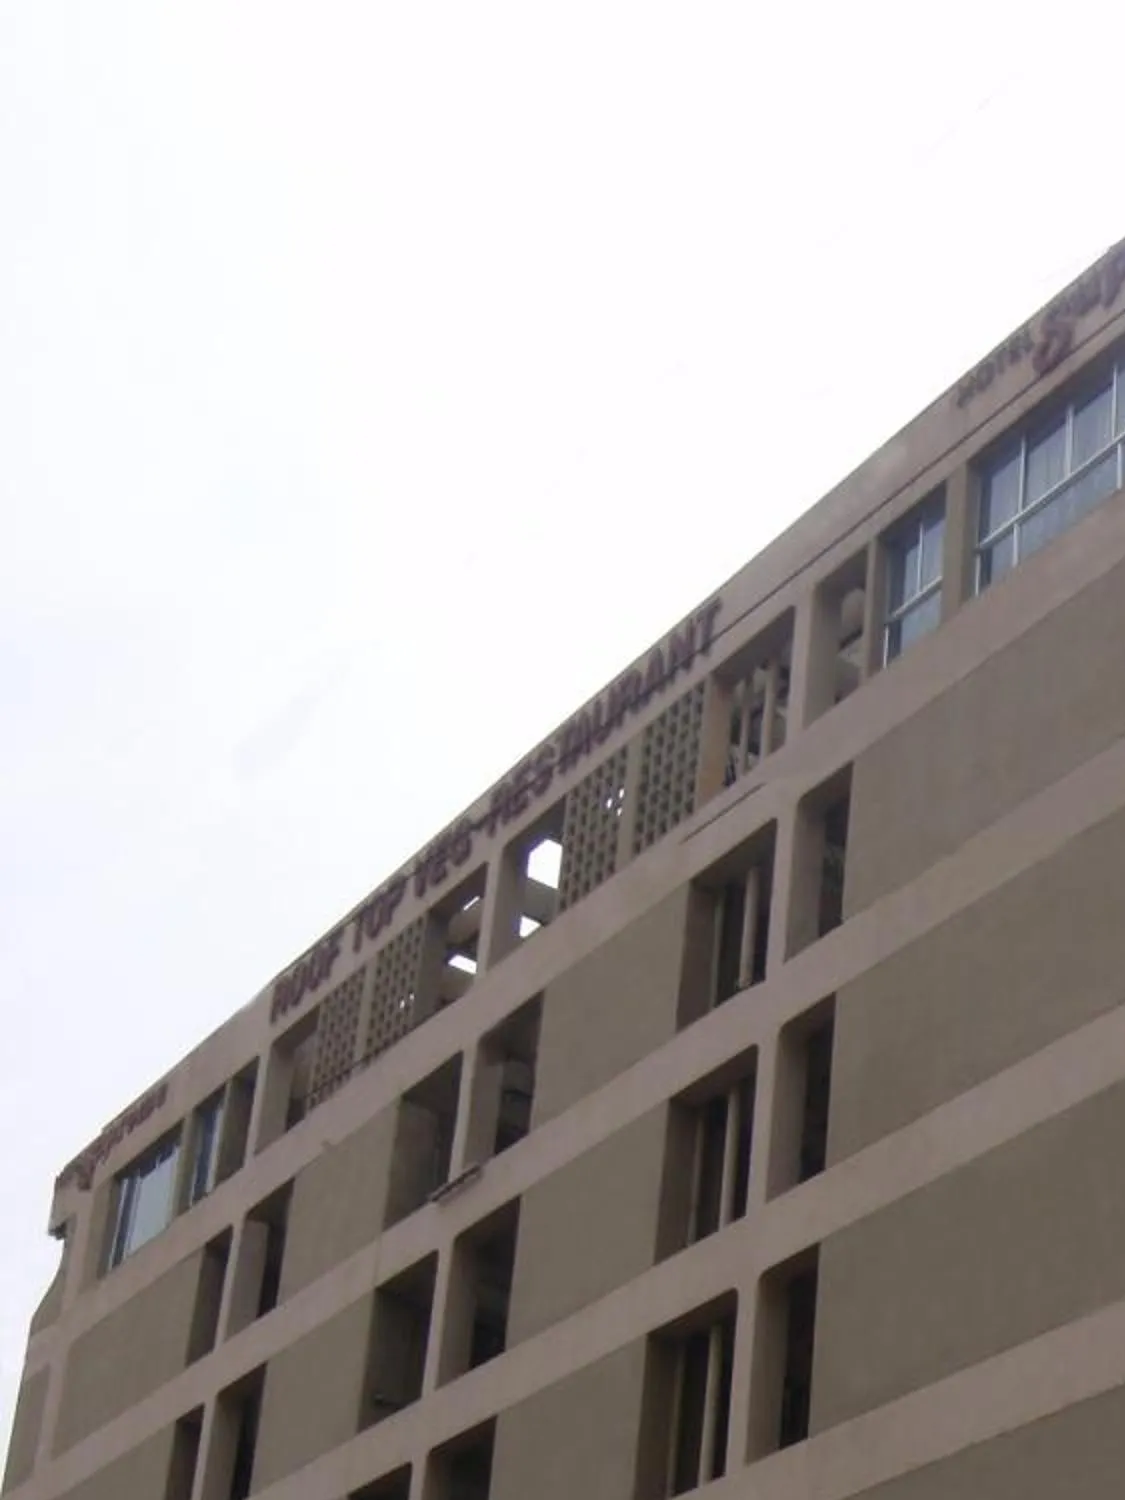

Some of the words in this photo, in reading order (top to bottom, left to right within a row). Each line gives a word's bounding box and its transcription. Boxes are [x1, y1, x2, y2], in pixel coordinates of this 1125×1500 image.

[269, 924, 342, 1026] ROOF
[353, 872, 411, 953] TOP
[415, 820, 474, 899] VEG
[486, 597, 723, 838] RESTAURANT
